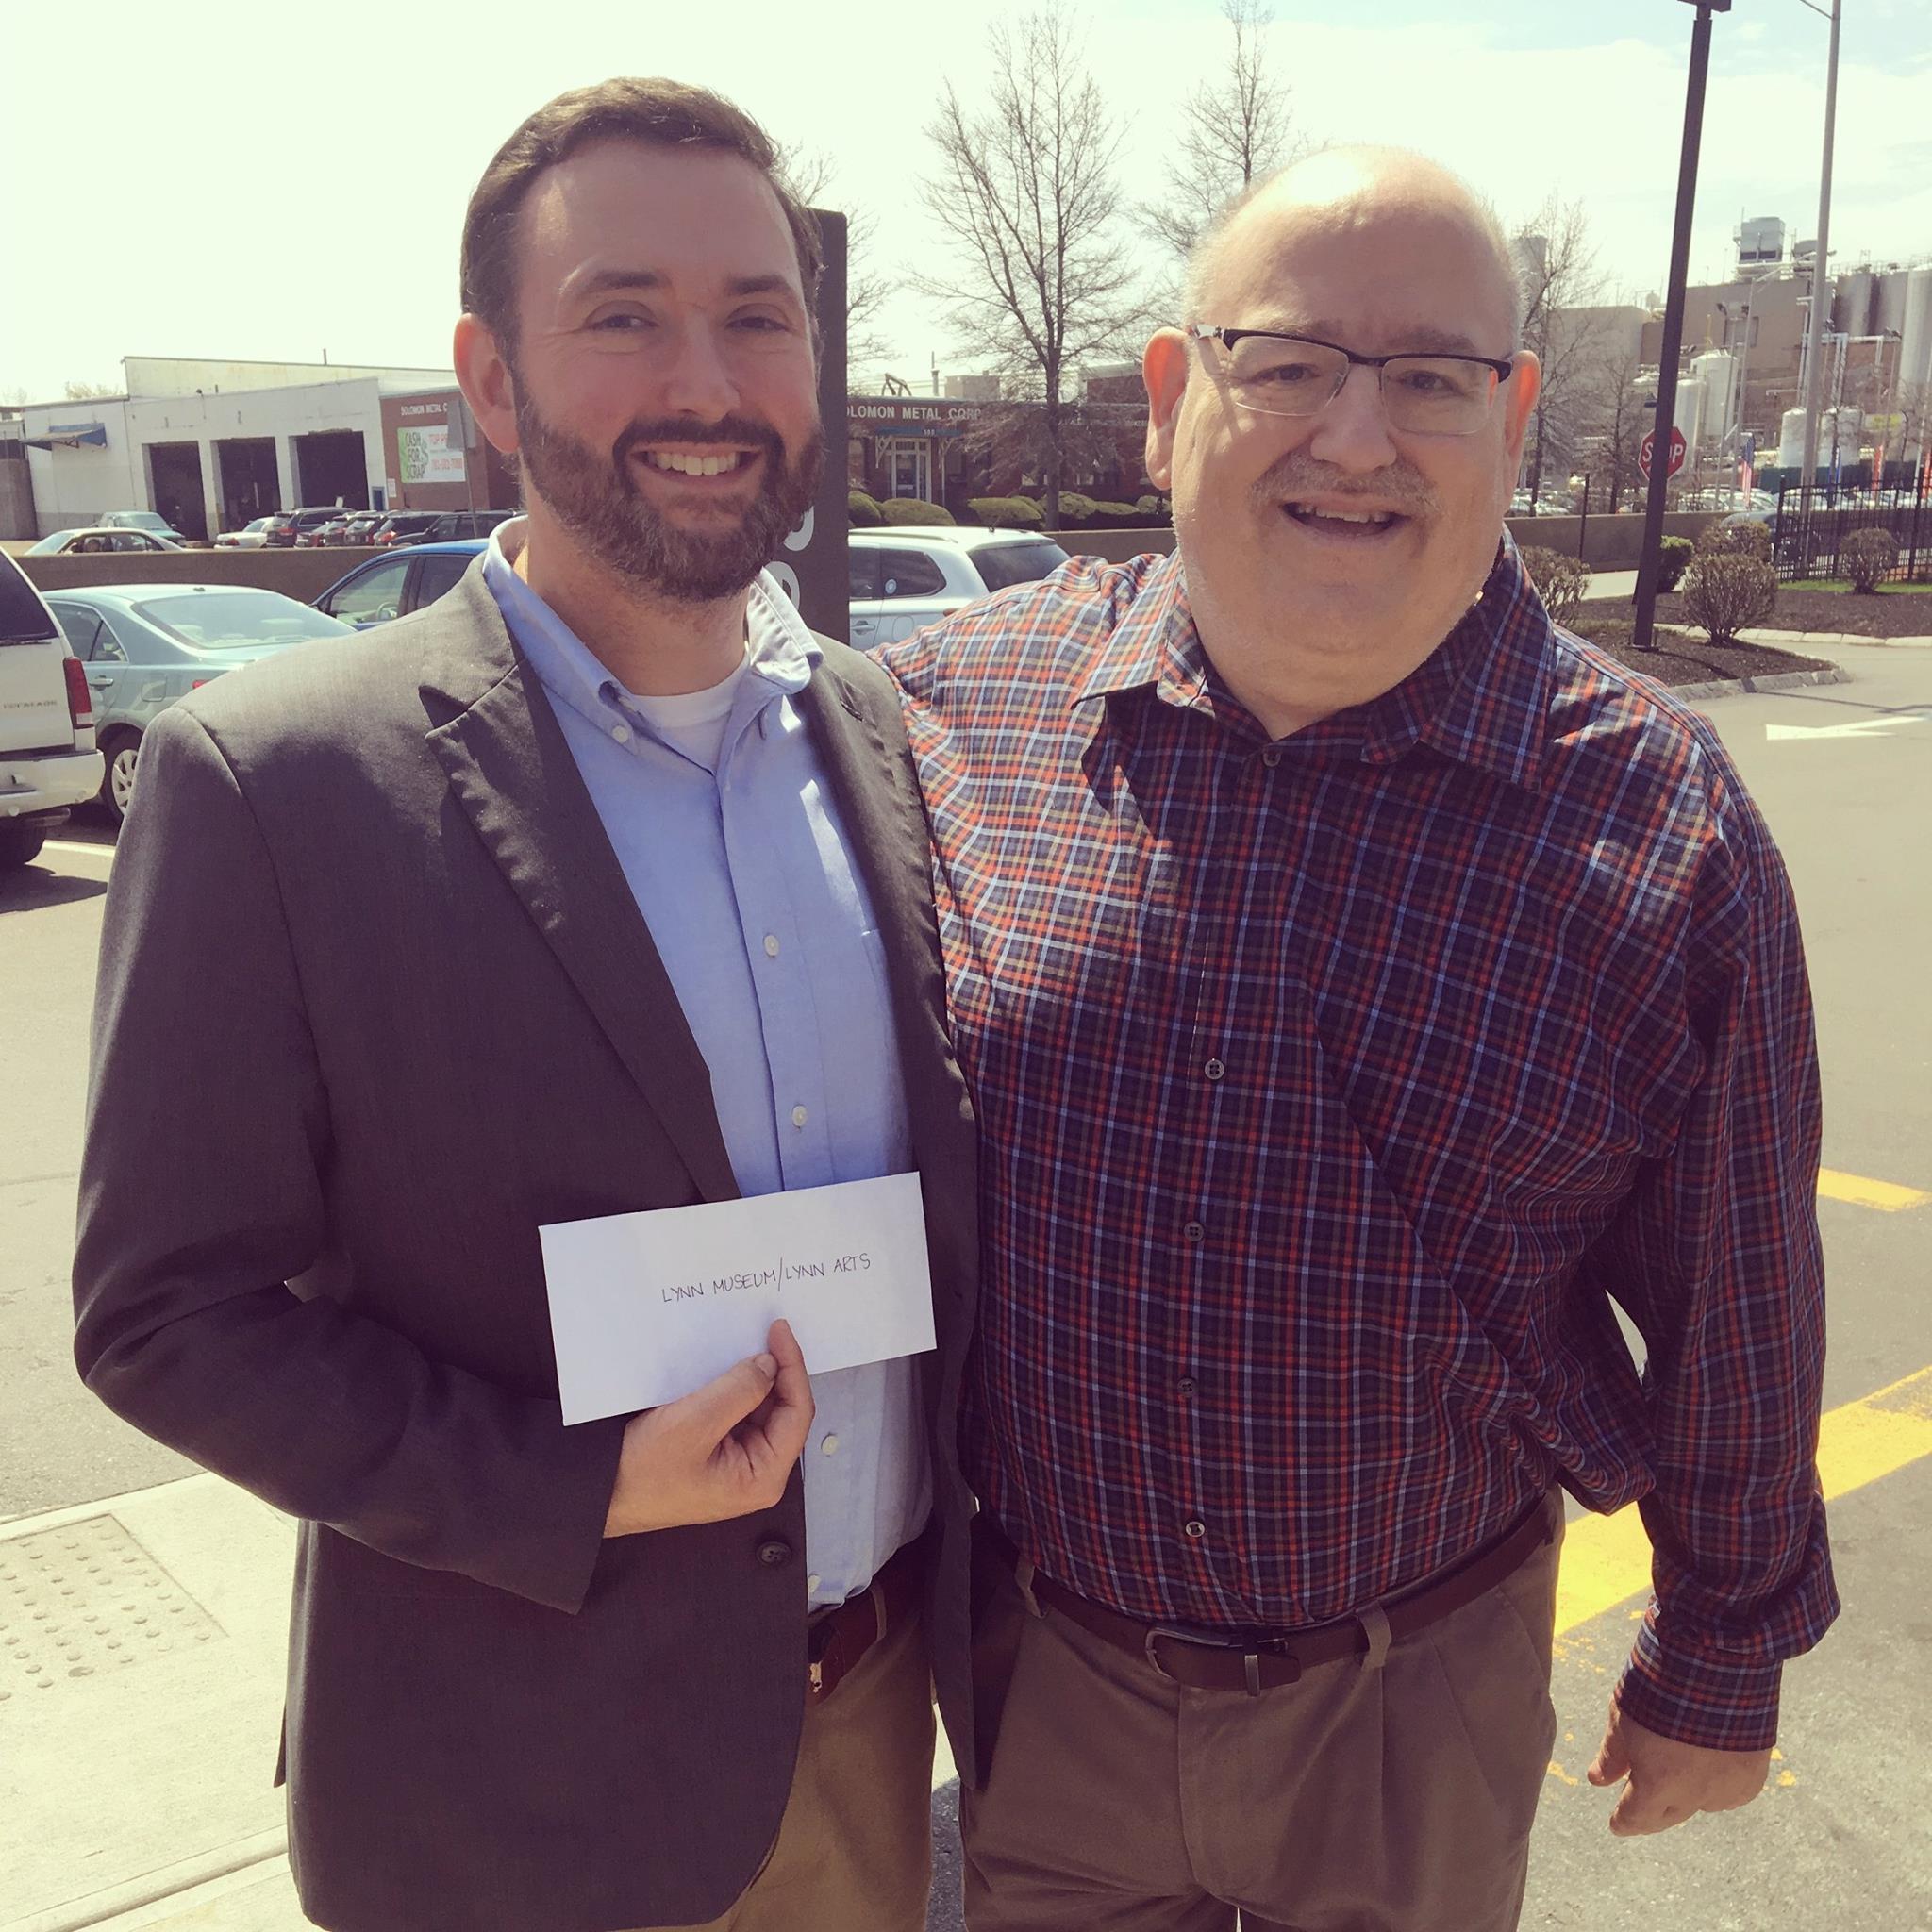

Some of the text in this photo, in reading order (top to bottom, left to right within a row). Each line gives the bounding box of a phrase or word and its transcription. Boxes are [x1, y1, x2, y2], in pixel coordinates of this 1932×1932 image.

[846, 406, 895, 419] LOMON
[902, 407, 941, 420] METAL
[406, 432, 421, 447] CASH
[407, 448, 420, 462] FOR
[1642, 441, 1684, 463] SP
[407, 464, 425, 479] SCRAP
[661, 1252, 871, 1303] LYNN MUSEUM/LYNN ARTS
